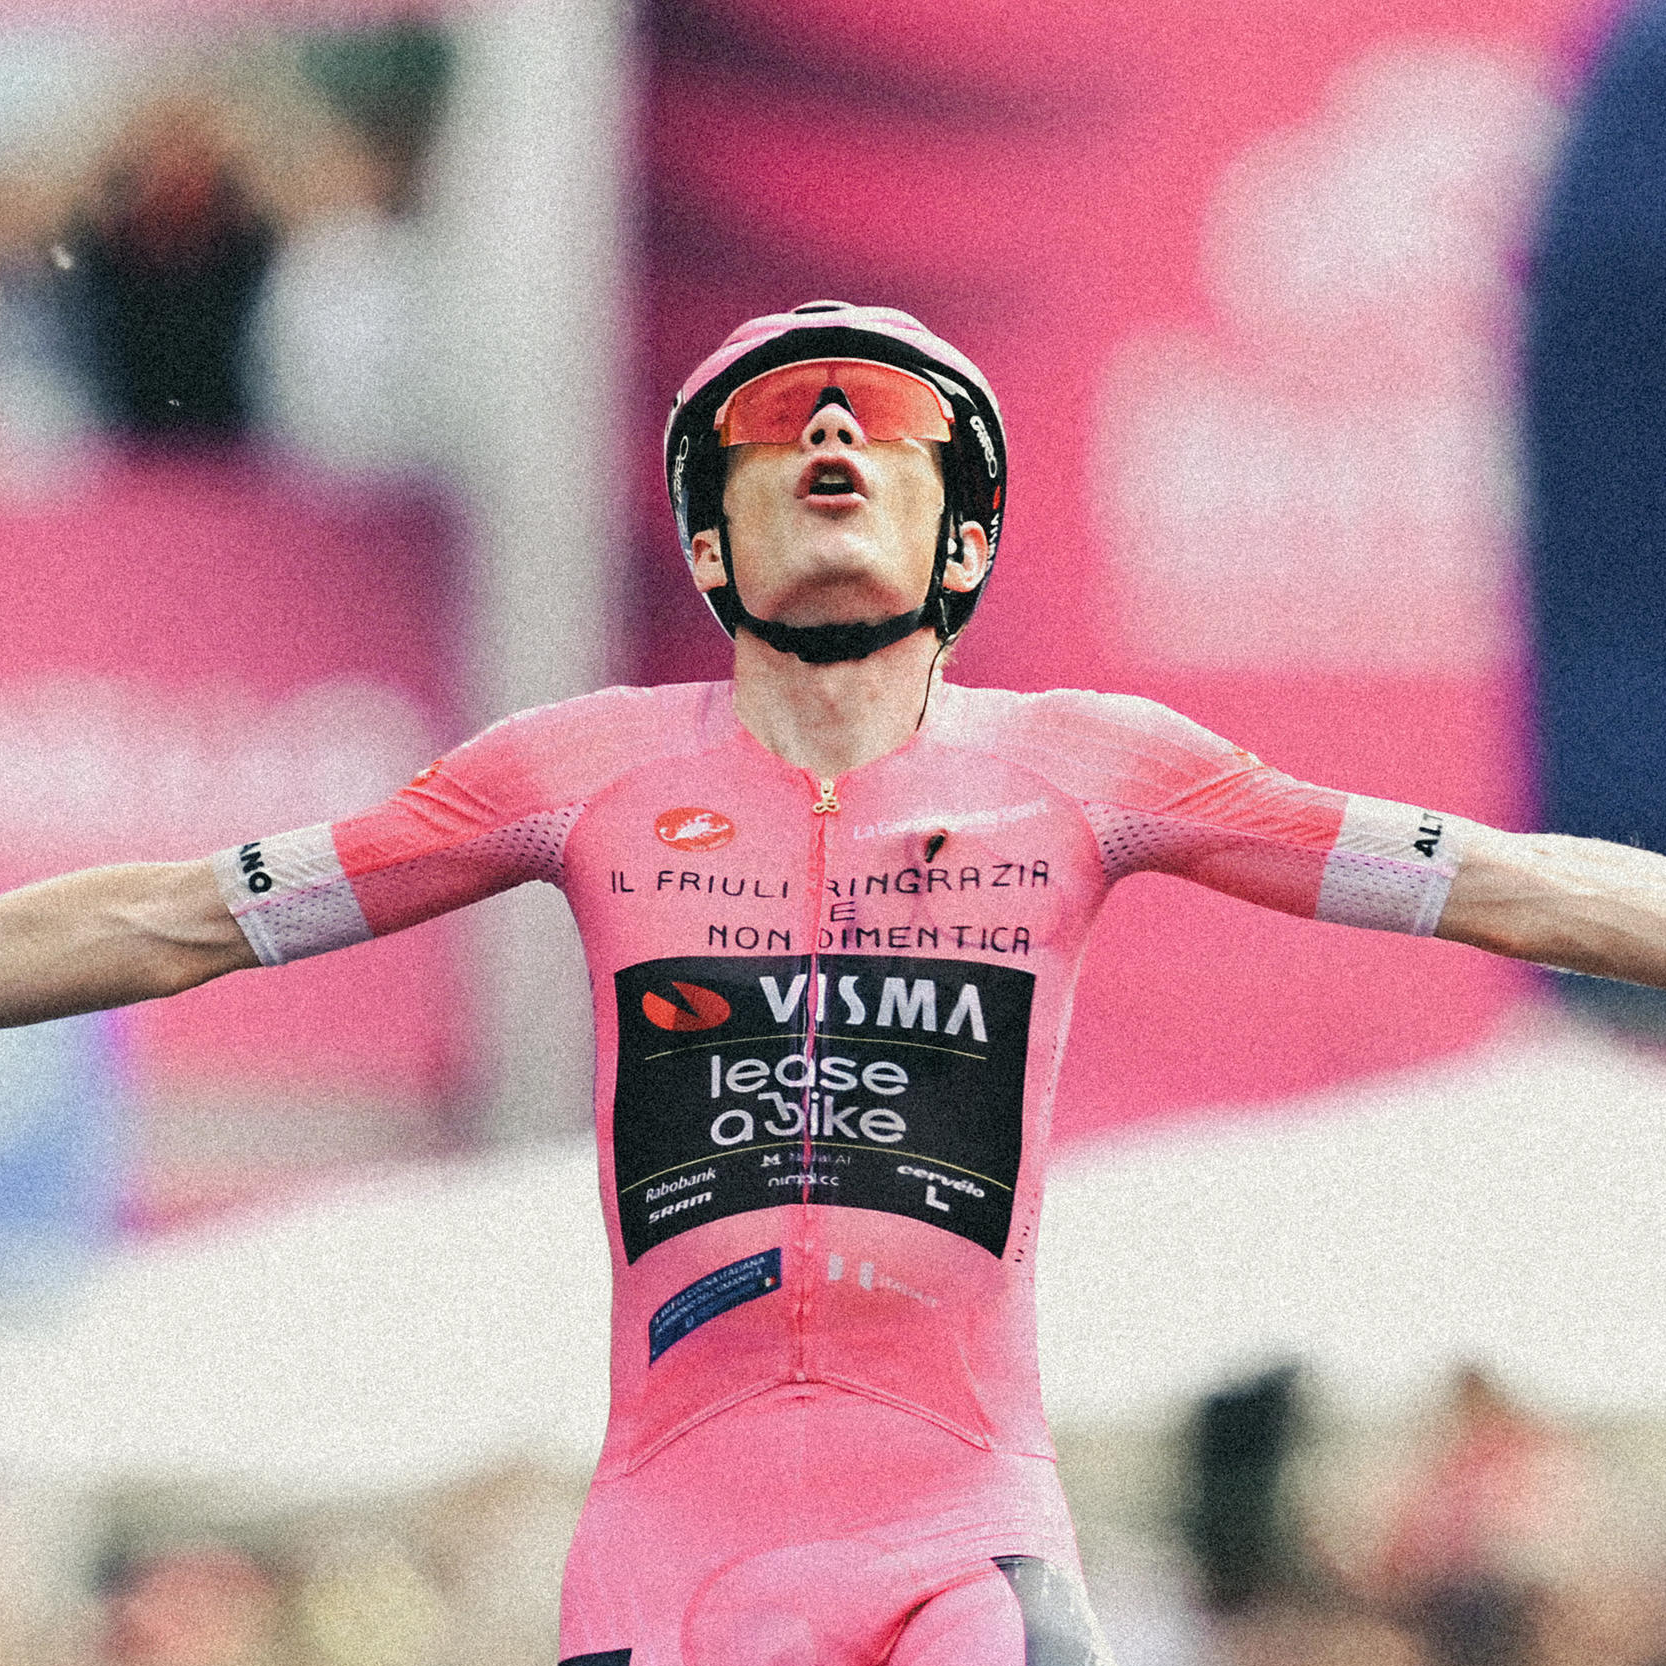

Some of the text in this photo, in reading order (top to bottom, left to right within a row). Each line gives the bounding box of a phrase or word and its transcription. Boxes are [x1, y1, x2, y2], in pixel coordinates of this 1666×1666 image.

[611, 870, 635, 894] IL
[657, 870, 788, 899] FRIULI
[830, 901, 856, 922] E
[708, 924, 1030, 957] NON DIMENTICA
[759, 973, 989, 1043] VISMA
[710, 1052, 909, 1100] lease
[645, 1167, 717, 1204] Rabobank
[896, 1165, 985, 1198] cervélo
